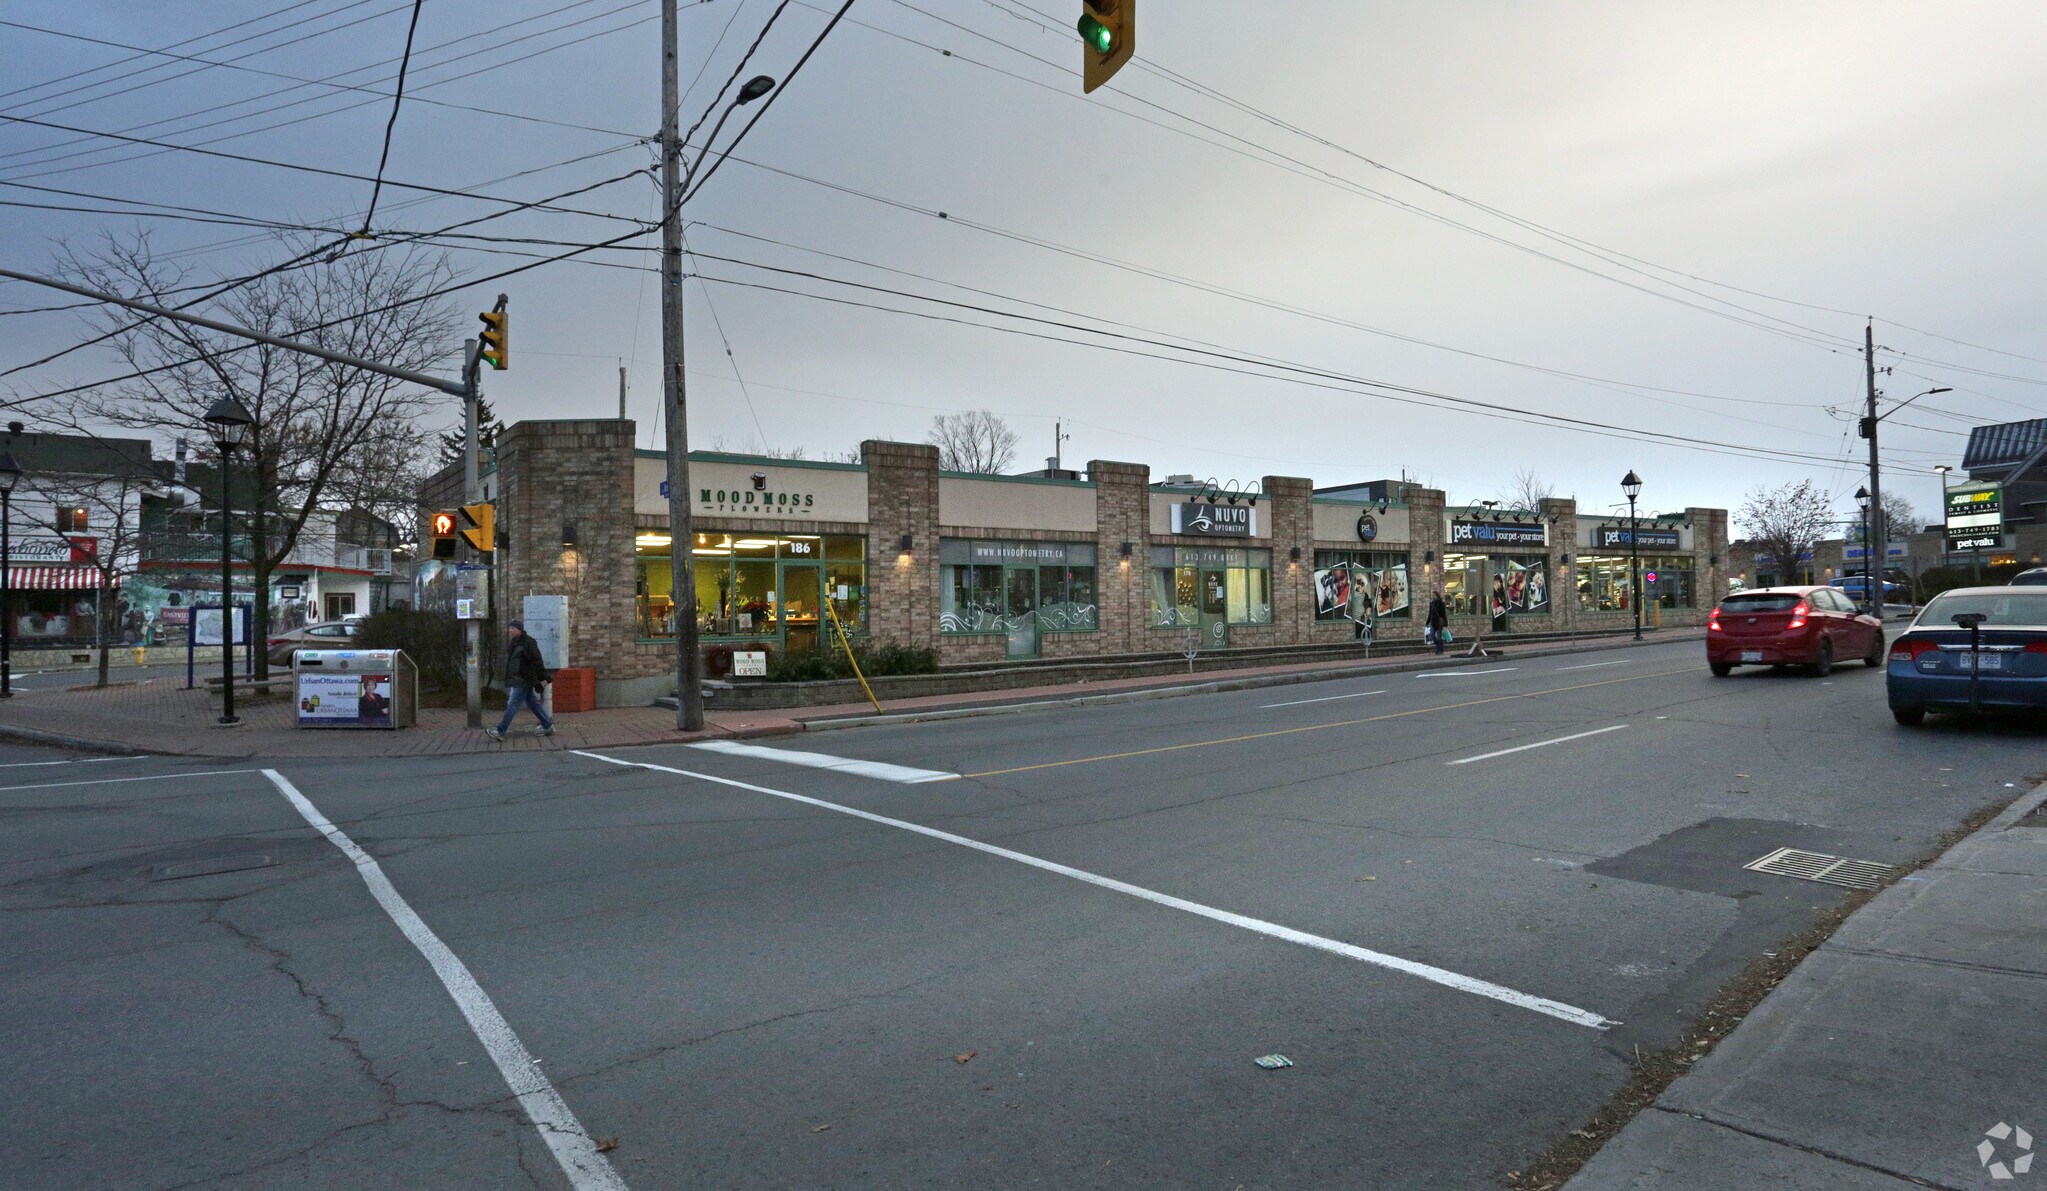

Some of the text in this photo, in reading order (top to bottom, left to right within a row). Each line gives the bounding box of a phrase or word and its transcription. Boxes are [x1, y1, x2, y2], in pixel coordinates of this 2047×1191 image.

[701, 489, 814, 507] MOOD MOSS
[1951, 492, 1994, 505] SUBWAY
[719, 504, 794, 514] FLOWERS
[1948, 502, 1999, 512] DENTIST
[1215, 507, 1246, 523] NUVO
[1215, 524, 1245, 532] OPTOMETRY
[1361, 524, 1370, 533] pet
[1453, 523, 1545, 542] pet valu your pet your store
[1949, 526, 2000, 534] 613-749-1785
[1604, 530, 1620, 546] pet
[1620, 530, 1637, 544] val
[790, 543, 811, 554] 186
[1957, 538, 1995, 550] pet valu
[977, 548, 1064, 558] WWW.NUVOOPTOMETRY.CA
[739, 667, 762, 675] OPEN
[301, 677, 360, 685] UrbanOttawa.com
